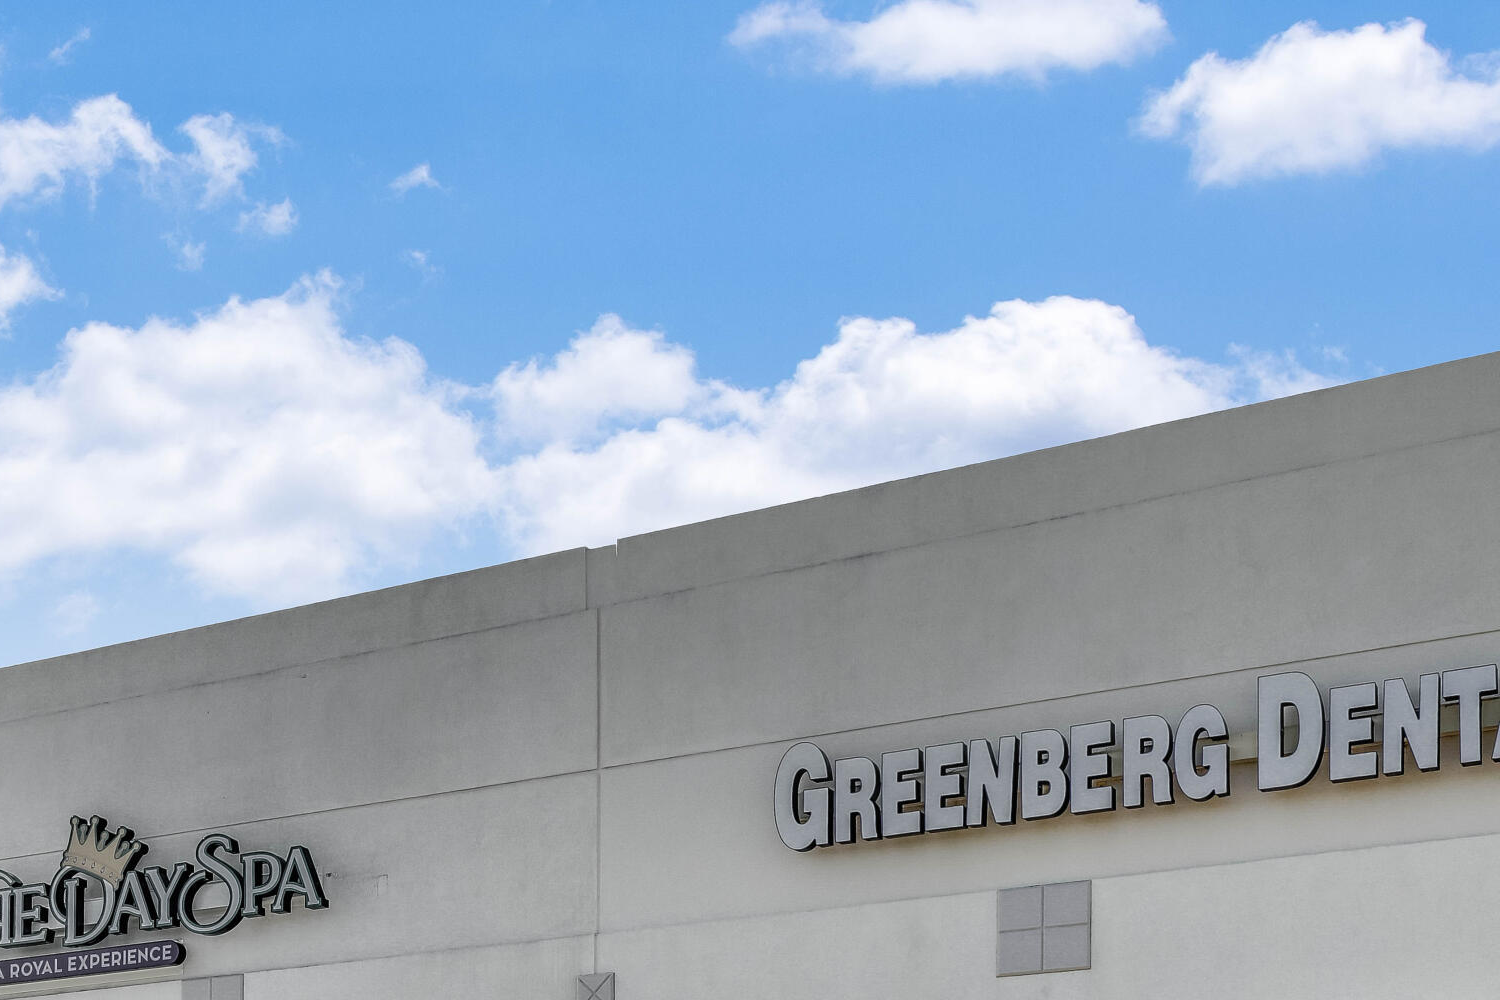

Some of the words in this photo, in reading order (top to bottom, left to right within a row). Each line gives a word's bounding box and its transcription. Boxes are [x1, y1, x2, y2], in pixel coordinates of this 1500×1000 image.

[773, 703, 1229, 852] GREENBERG
[1257, 663, 1500, 793] DENT
[49, 862, 194, 948] DAY
[178, 833, 331, 936] SPA
[9, 958, 63, 979] ROYAL
[67, 944, 173, 972] EXPERIENCE
